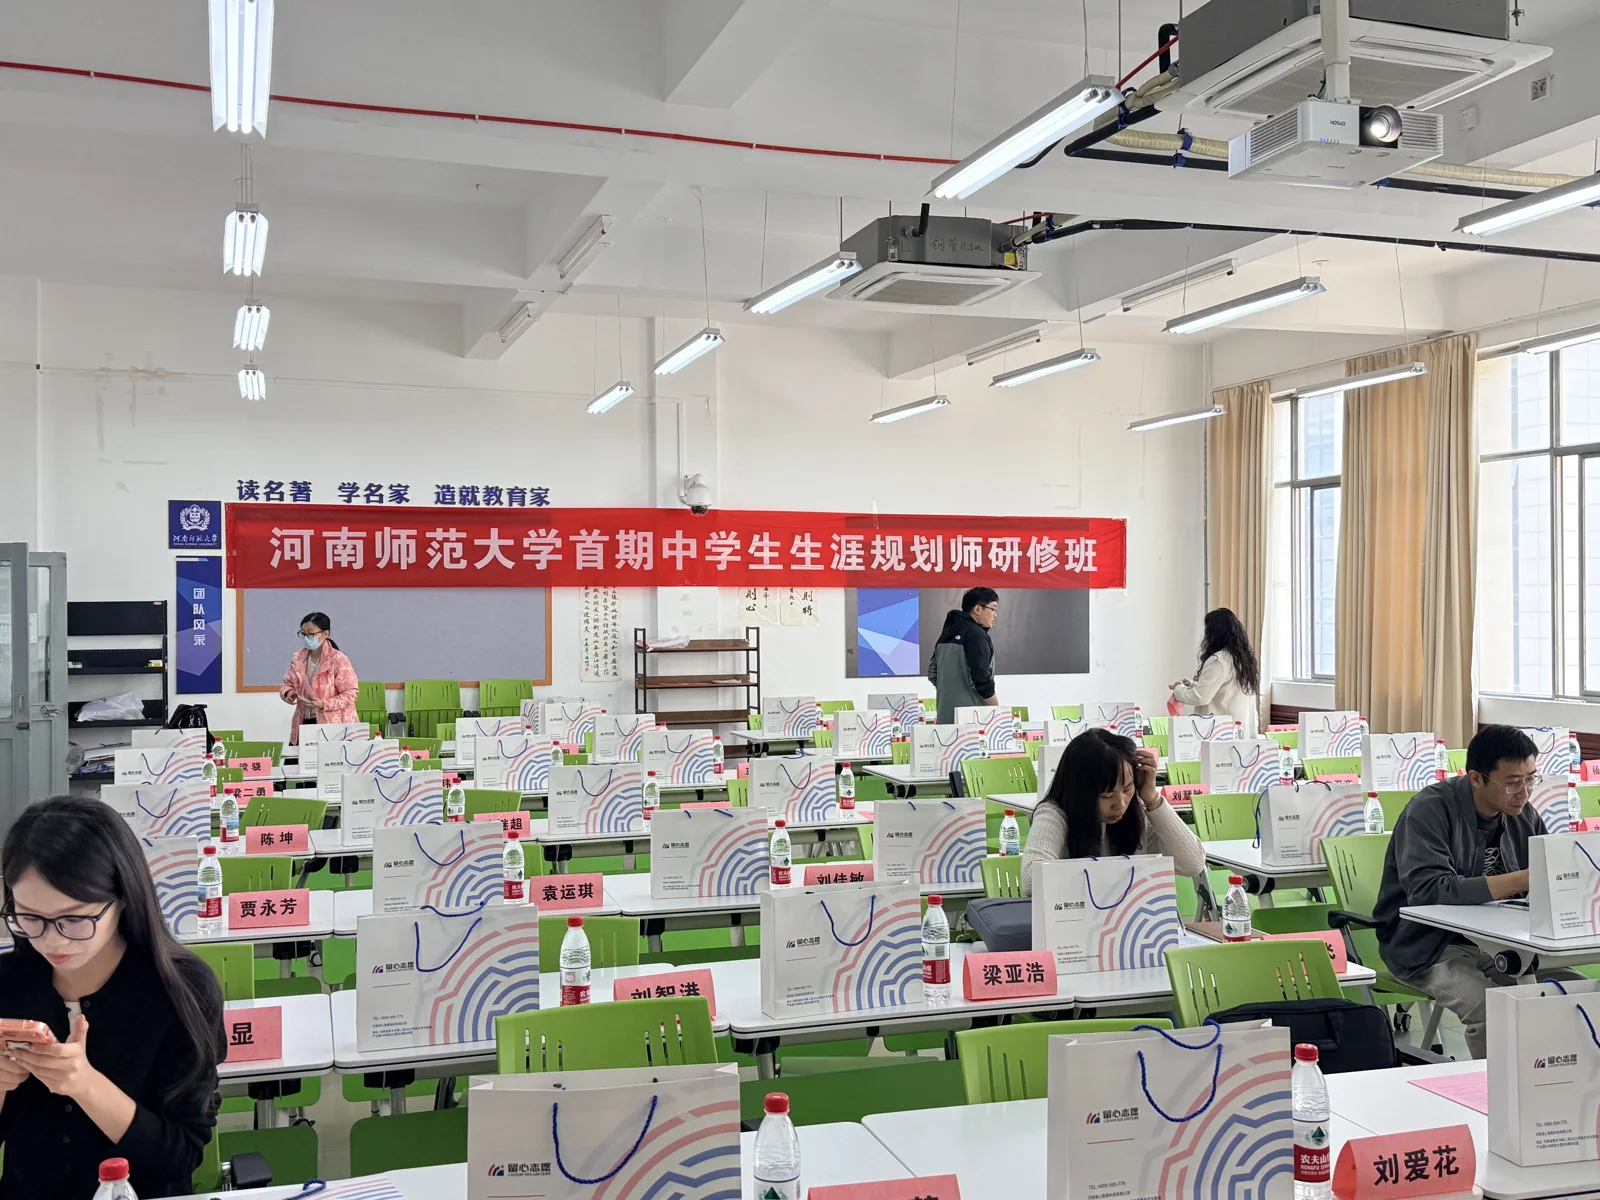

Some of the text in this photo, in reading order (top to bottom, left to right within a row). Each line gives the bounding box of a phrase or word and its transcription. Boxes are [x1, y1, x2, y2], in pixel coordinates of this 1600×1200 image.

[237, 480, 551, 507] 读名著 学名家 造就教育家
[269, 526, 1098, 573] 河南师范大学首期中学生生涯规划师研修班
[193, 588, 206, 646] 团队风采
[261, 832, 293, 845] 陈坤
[542, 883, 594, 901] 袁运琪
[240, 898, 297, 918] 贾永芳
[983, 962, 1045, 986] 梁亚浩
[1103, 1107, 1139, 1119] 留心志愿
[508, 1163, 551, 1172] 留心志愿
[1373, 1145, 1459, 1186] 刘爱花
